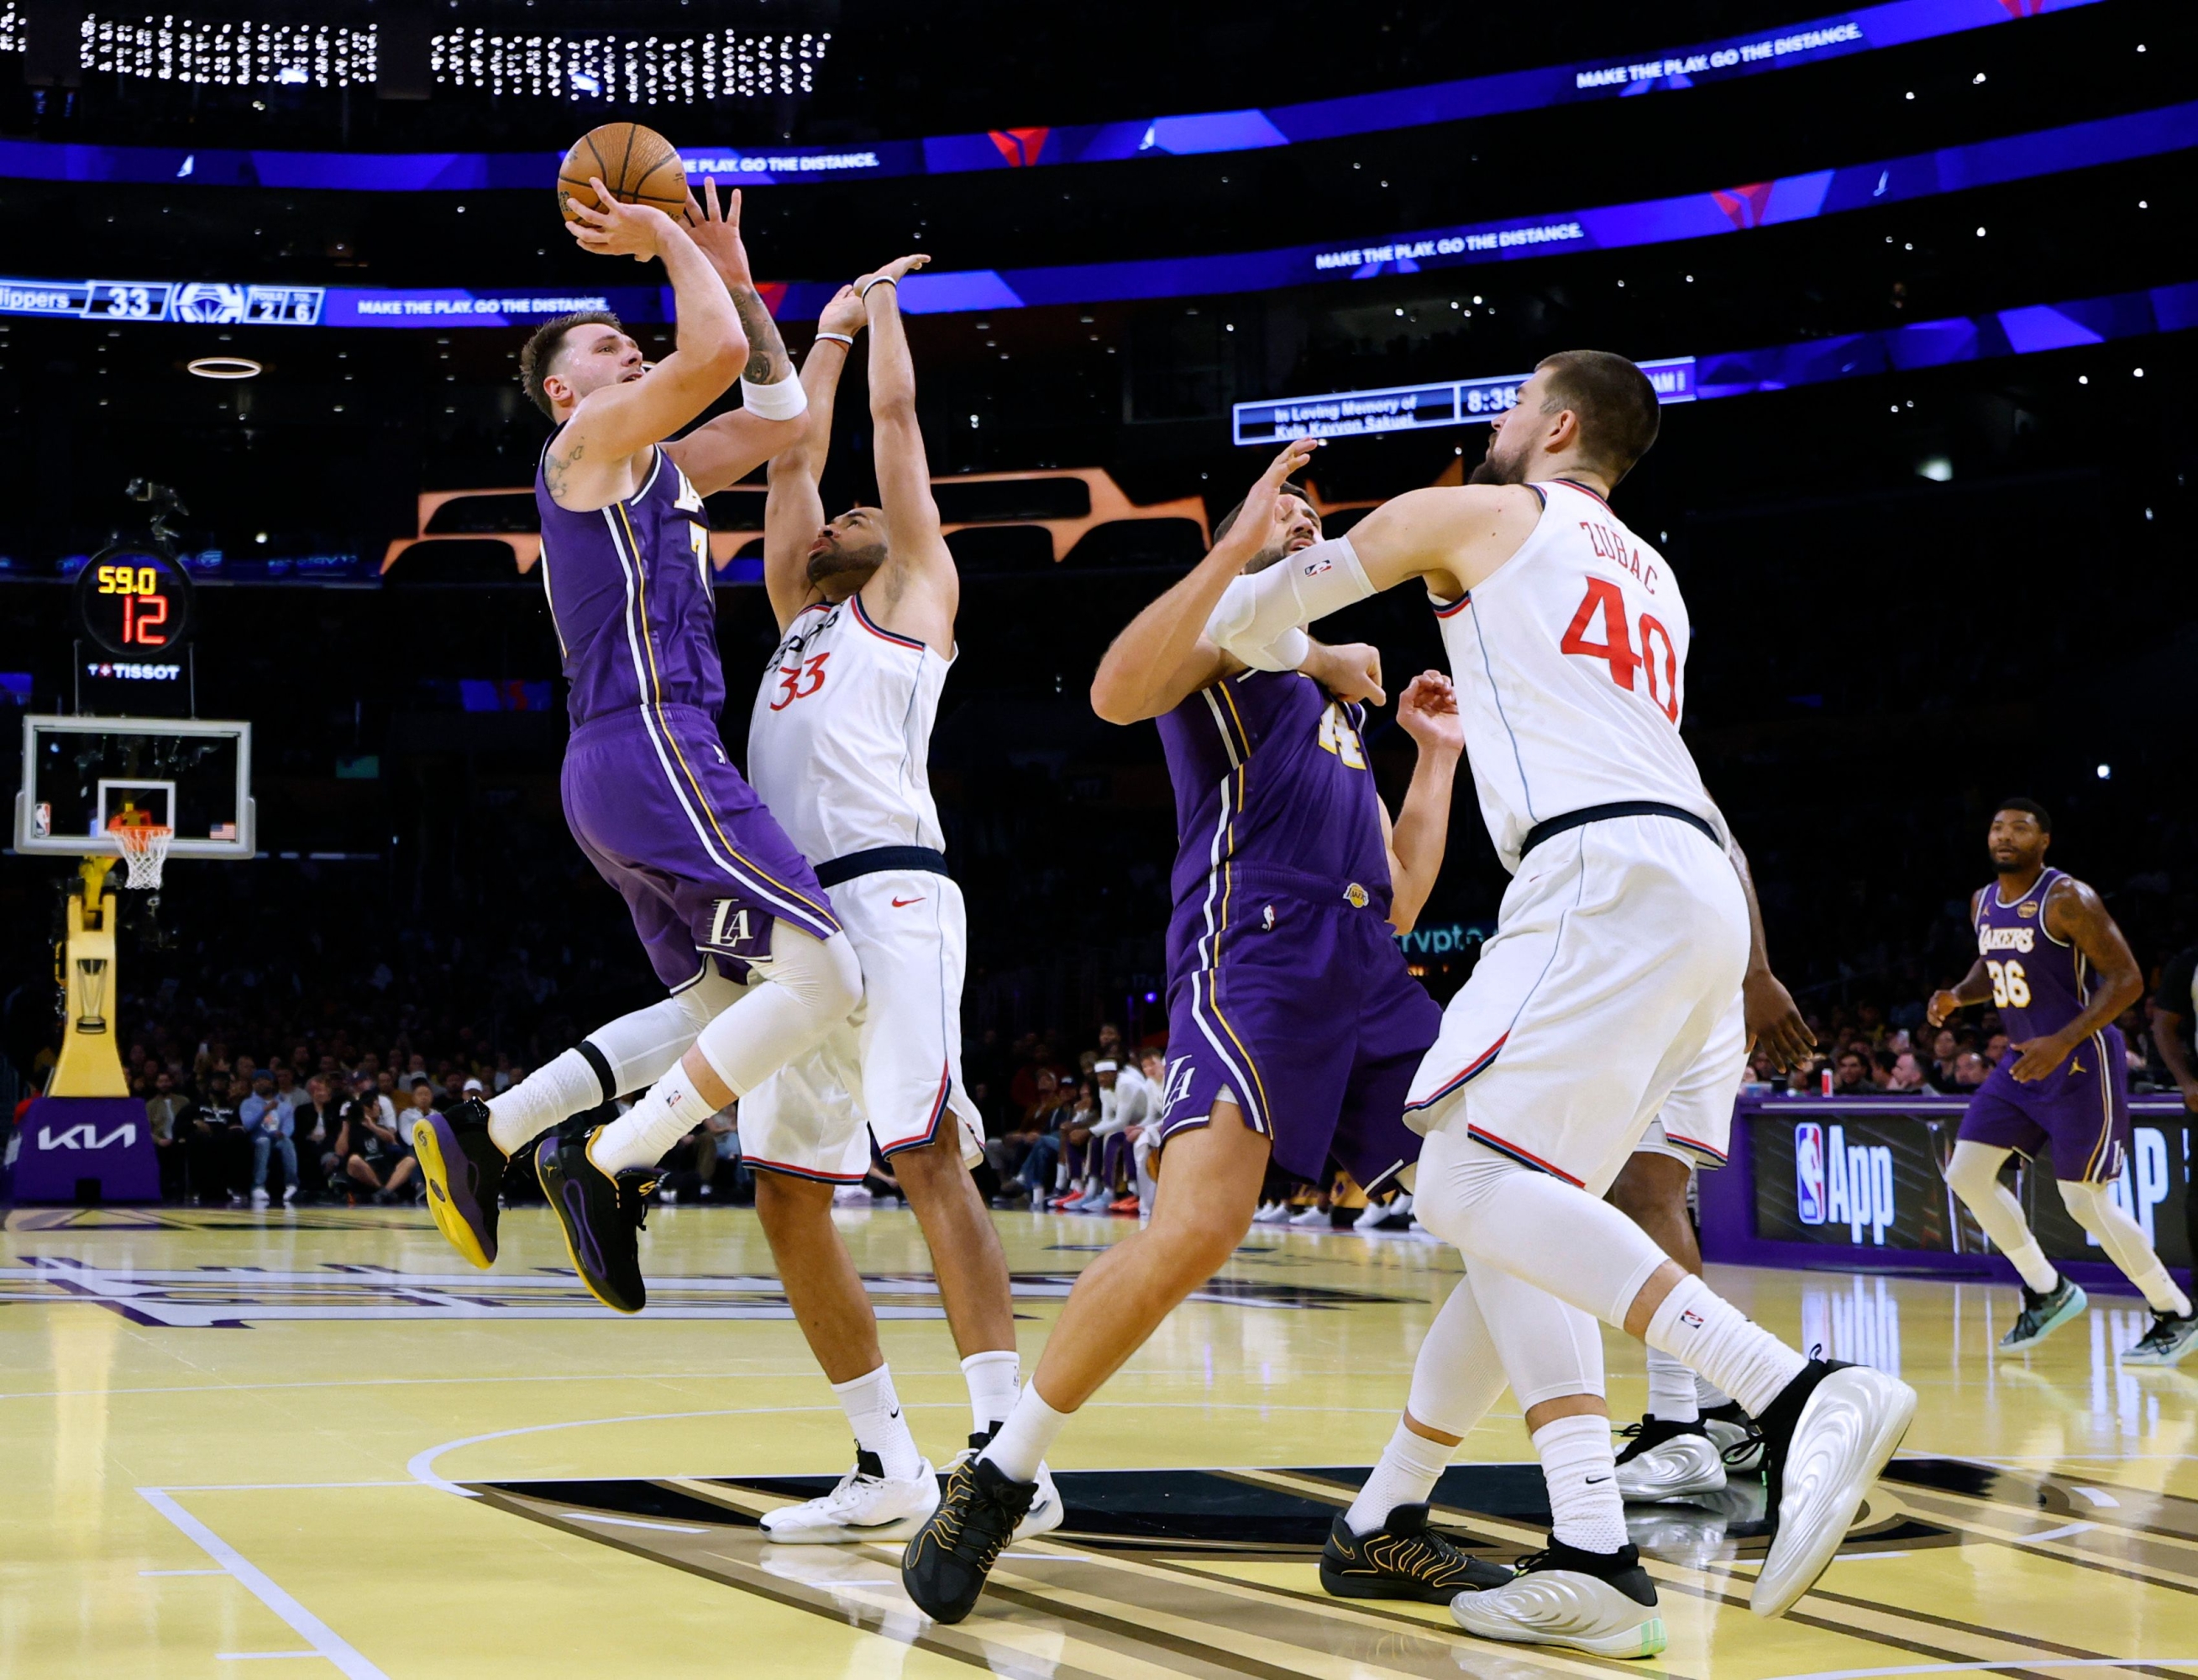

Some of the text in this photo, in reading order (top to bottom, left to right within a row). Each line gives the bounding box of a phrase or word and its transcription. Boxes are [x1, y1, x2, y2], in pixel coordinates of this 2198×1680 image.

[1576, 23, 1863, 88] MAKE THE PLAY. GO THE DISTANCE.
[699, 158, 739, 172] PLAY.
[740, 157, 767, 172] GO
[768, 157, 798, 171] THE
[800, 152, 879, 171] DISTANCE.
[1316, 223, 1583, 269] MAKE THE PLAY. GO THE DISTANCE.
[108, 287, 150, 318] 33
[260, 302, 275, 320] 2
[295, 302, 310, 322] 6
[358, 297, 610, 314] MAKE THE PLAY. GO THE DISTANCE.
[1274, 394, 1418, 423] In Loving Memory of
[1579, 521, 1658, 595] ZUBAC
[98, 565, 156, 595] 59.0
[123, 595, 167, 644] 12
[1561, 575, 1678, 727] 40
[113, 663, 180, 680] TISSOT
[770, 652, 830, 711] 33
[706, 899, 753, 948] LA
[1978, 924, 2034, 955] LAKERS
[1986, 959, 2031, 1008] 36
[39, 1123, 136, 1150] KIA
[1828, 1125, 1895, 1246] App
